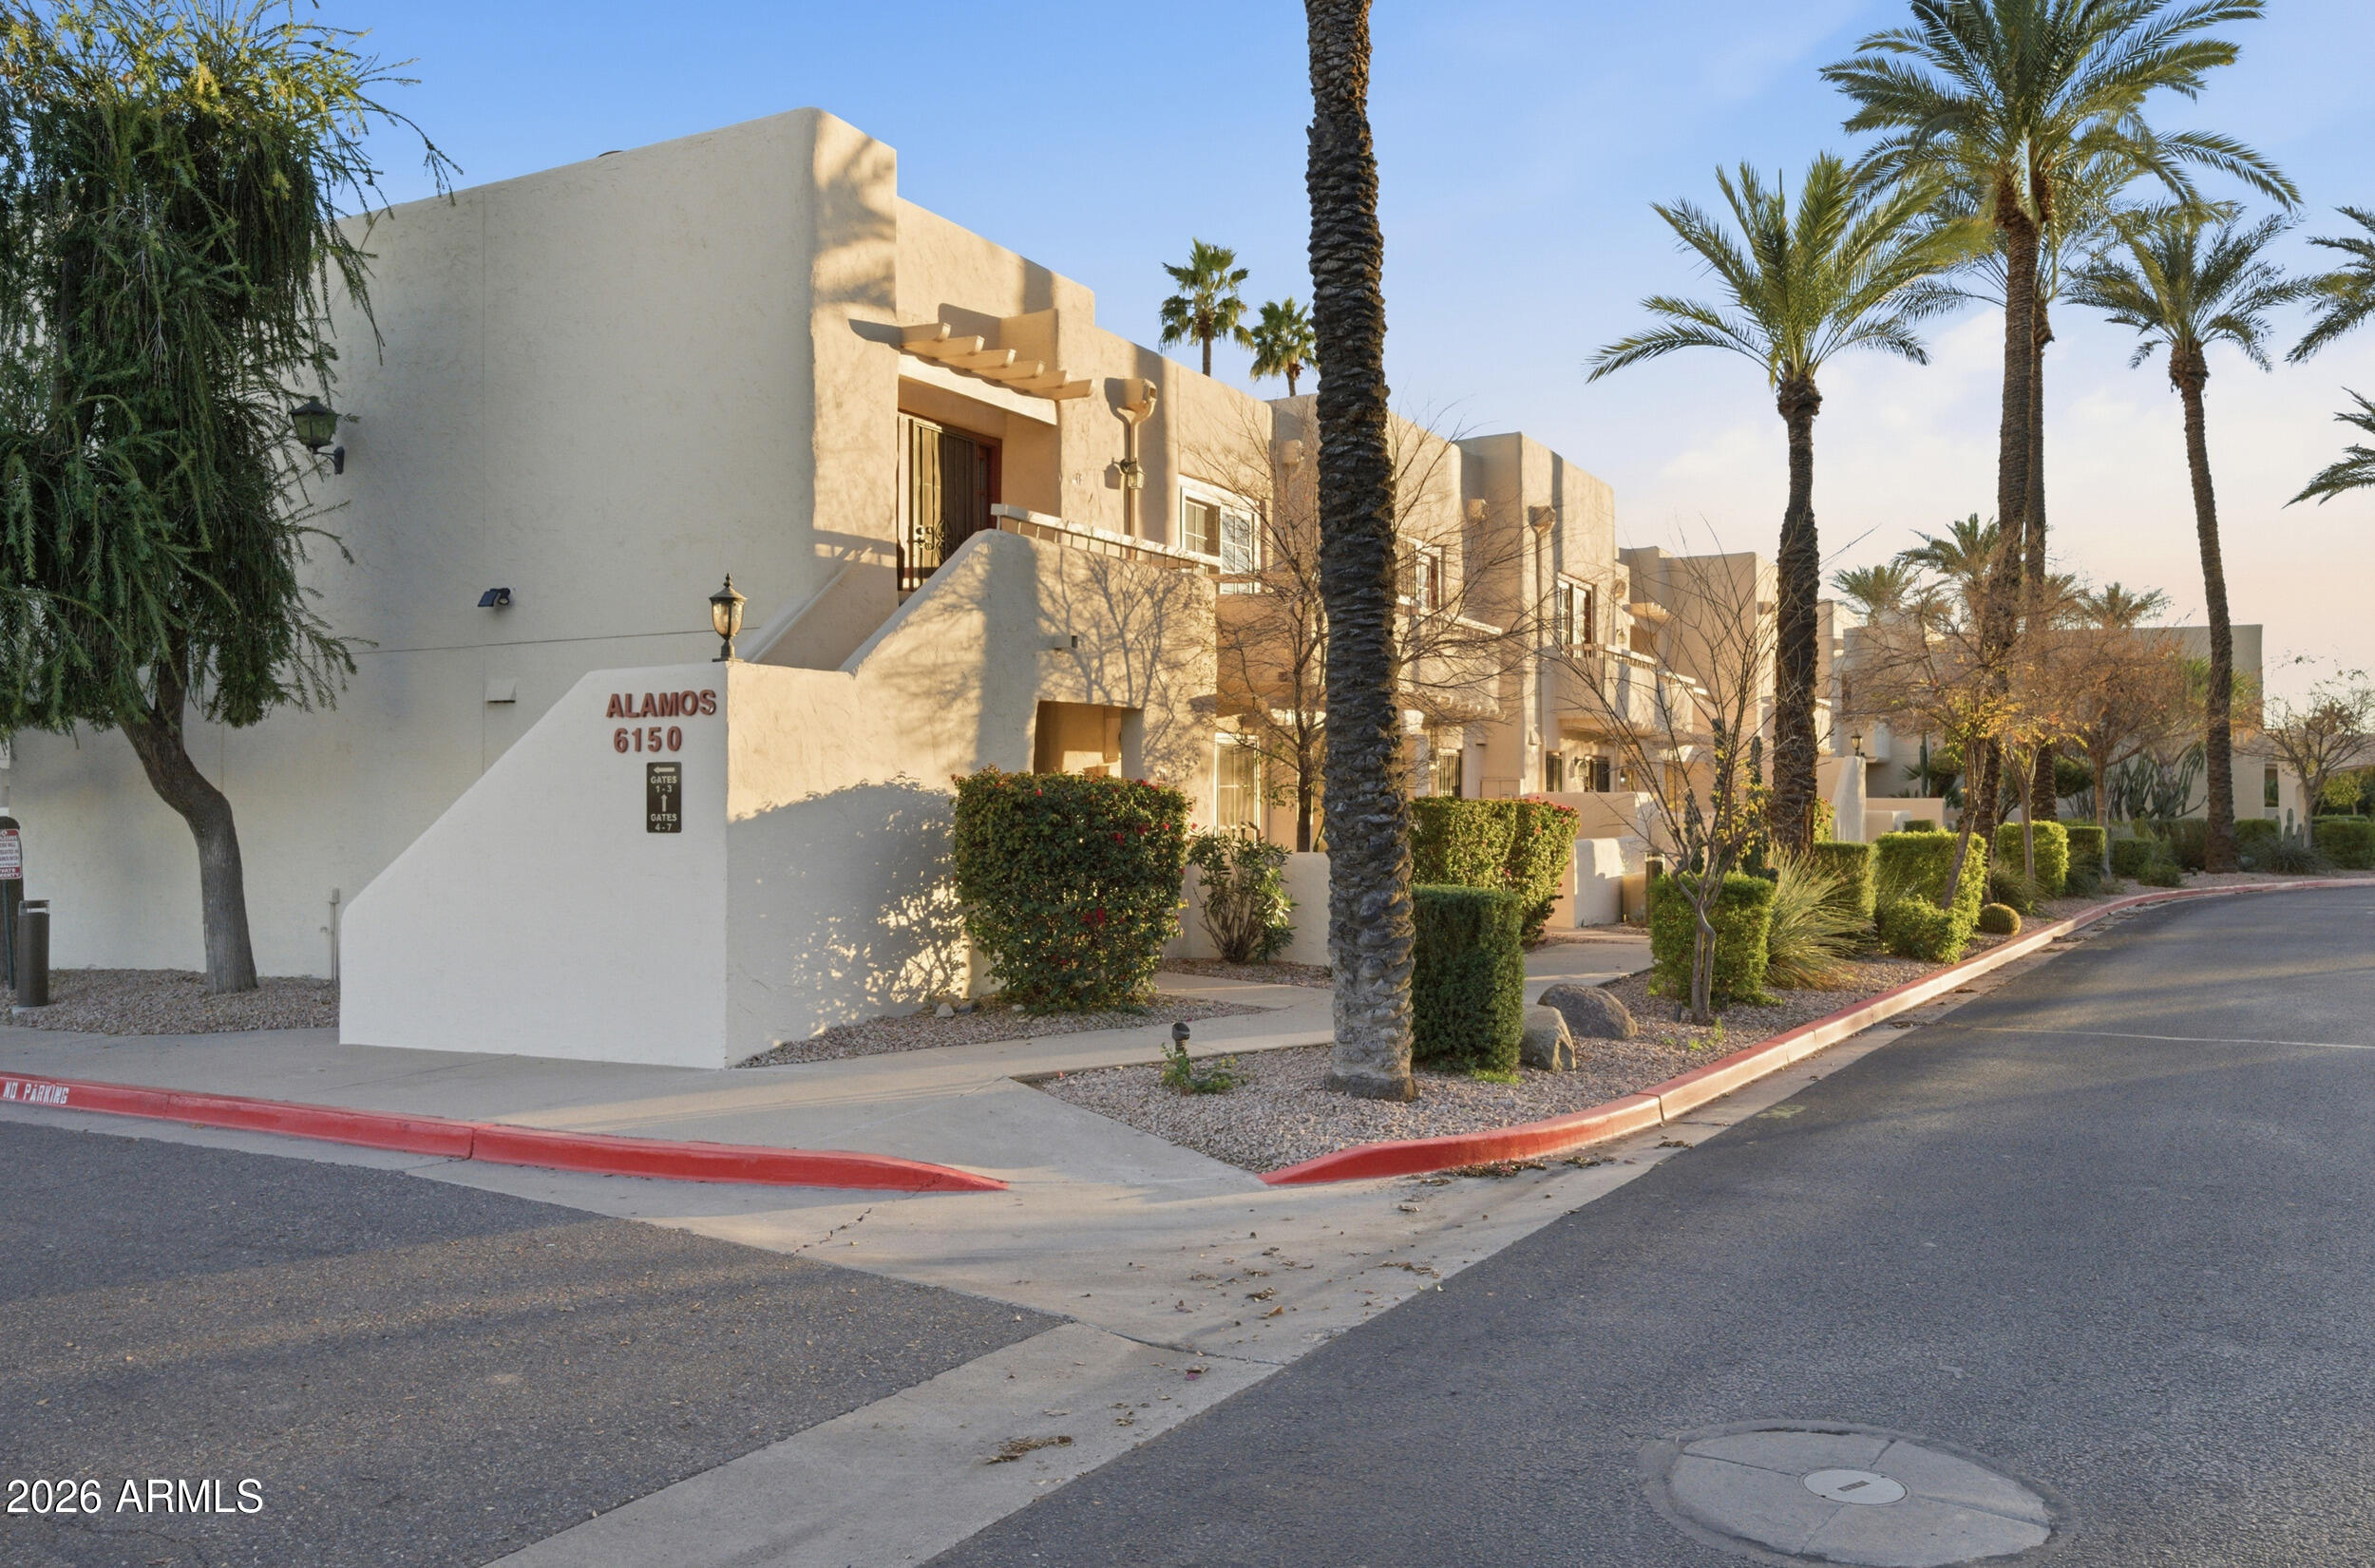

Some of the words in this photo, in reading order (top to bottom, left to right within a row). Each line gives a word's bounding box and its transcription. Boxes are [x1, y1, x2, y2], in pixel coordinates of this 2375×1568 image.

[605, 690, 716, 718] ALAMOS
[614, 726, 682, 753] 6150
[650, 775, 677, 784] GATES
[650, 813, 677, 822] GATES
[3, 1081, 19, 1100] NO
[23, 1083, 69, 1105] PARKING
